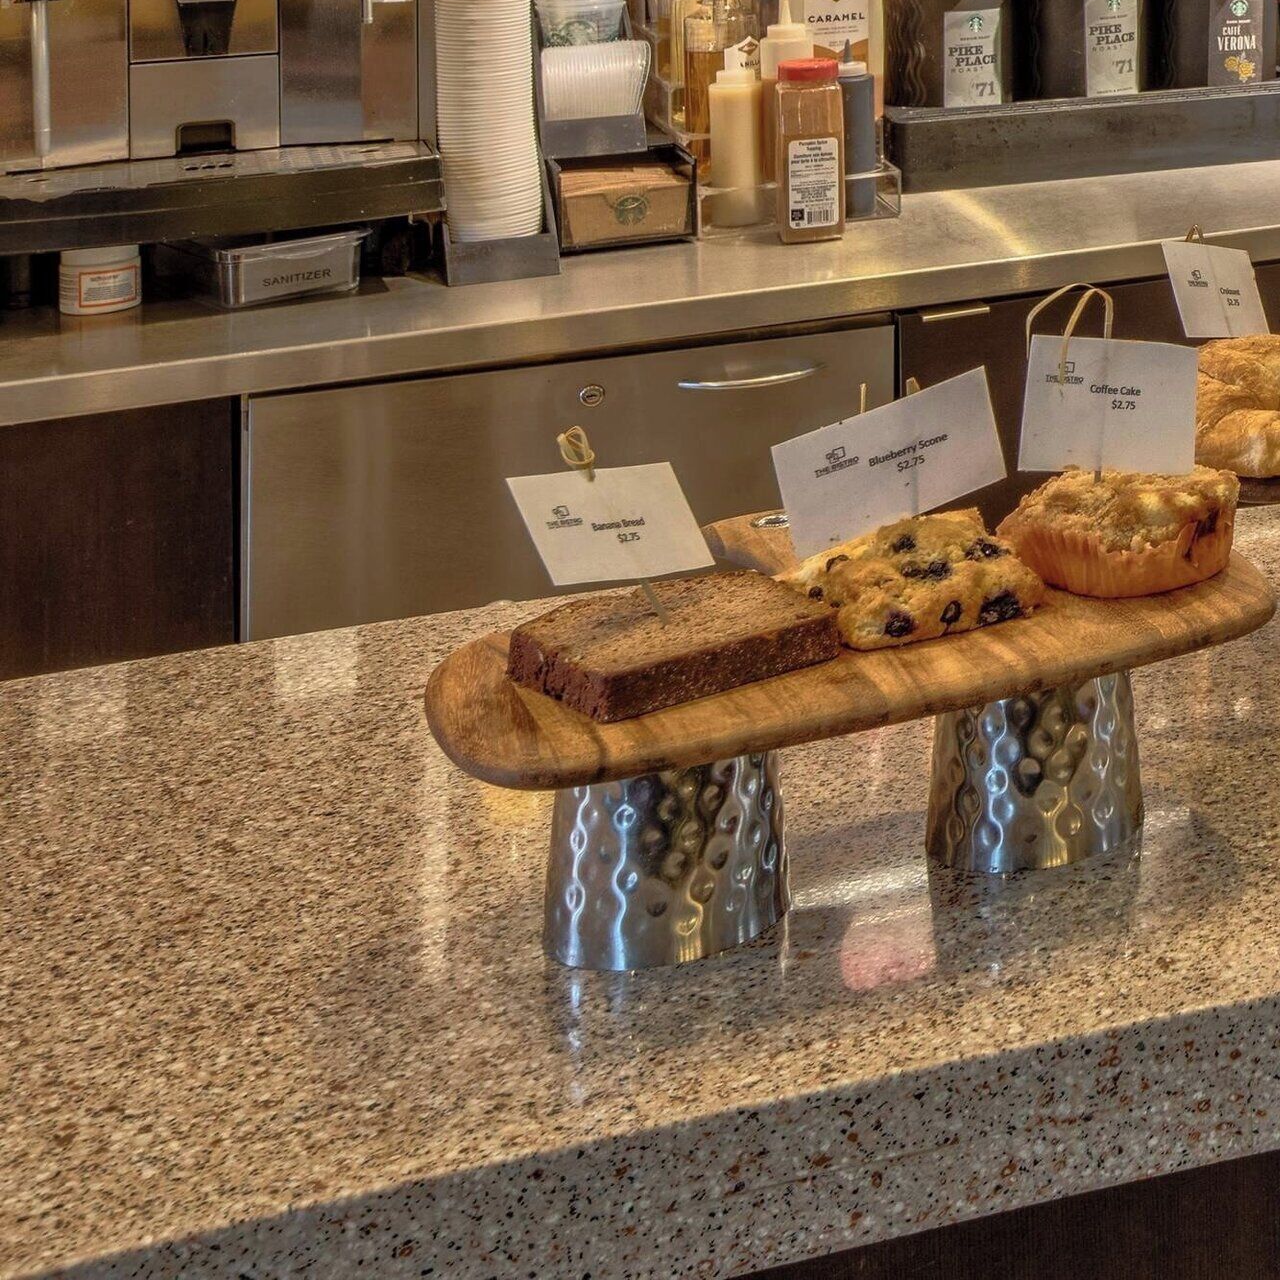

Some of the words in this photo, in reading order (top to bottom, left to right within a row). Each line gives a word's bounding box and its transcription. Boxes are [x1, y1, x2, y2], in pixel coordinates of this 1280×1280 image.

[808, 13, 865, 23] CARAMEL
[1089, 24, 1121, 36] PIKE
[1096, 32, 1135, 45] PLACE
[1217, 35, 1256, 51] VERONA
[948, 45, 983, 57] PIKE
[955, 54, 997, 67] PLACE
[262, 268, 331, 288] SANITIZER
[1090, 384, 1118, 394] Coffee
[1120, 386, 1141, 396] Cake
[1112, 400, 1136, 410] $2.75
[869, 444, 917, 467] Blueberry
[919, 434, 948, 450] Scone
[898, 455, 925, 472] $2.75
